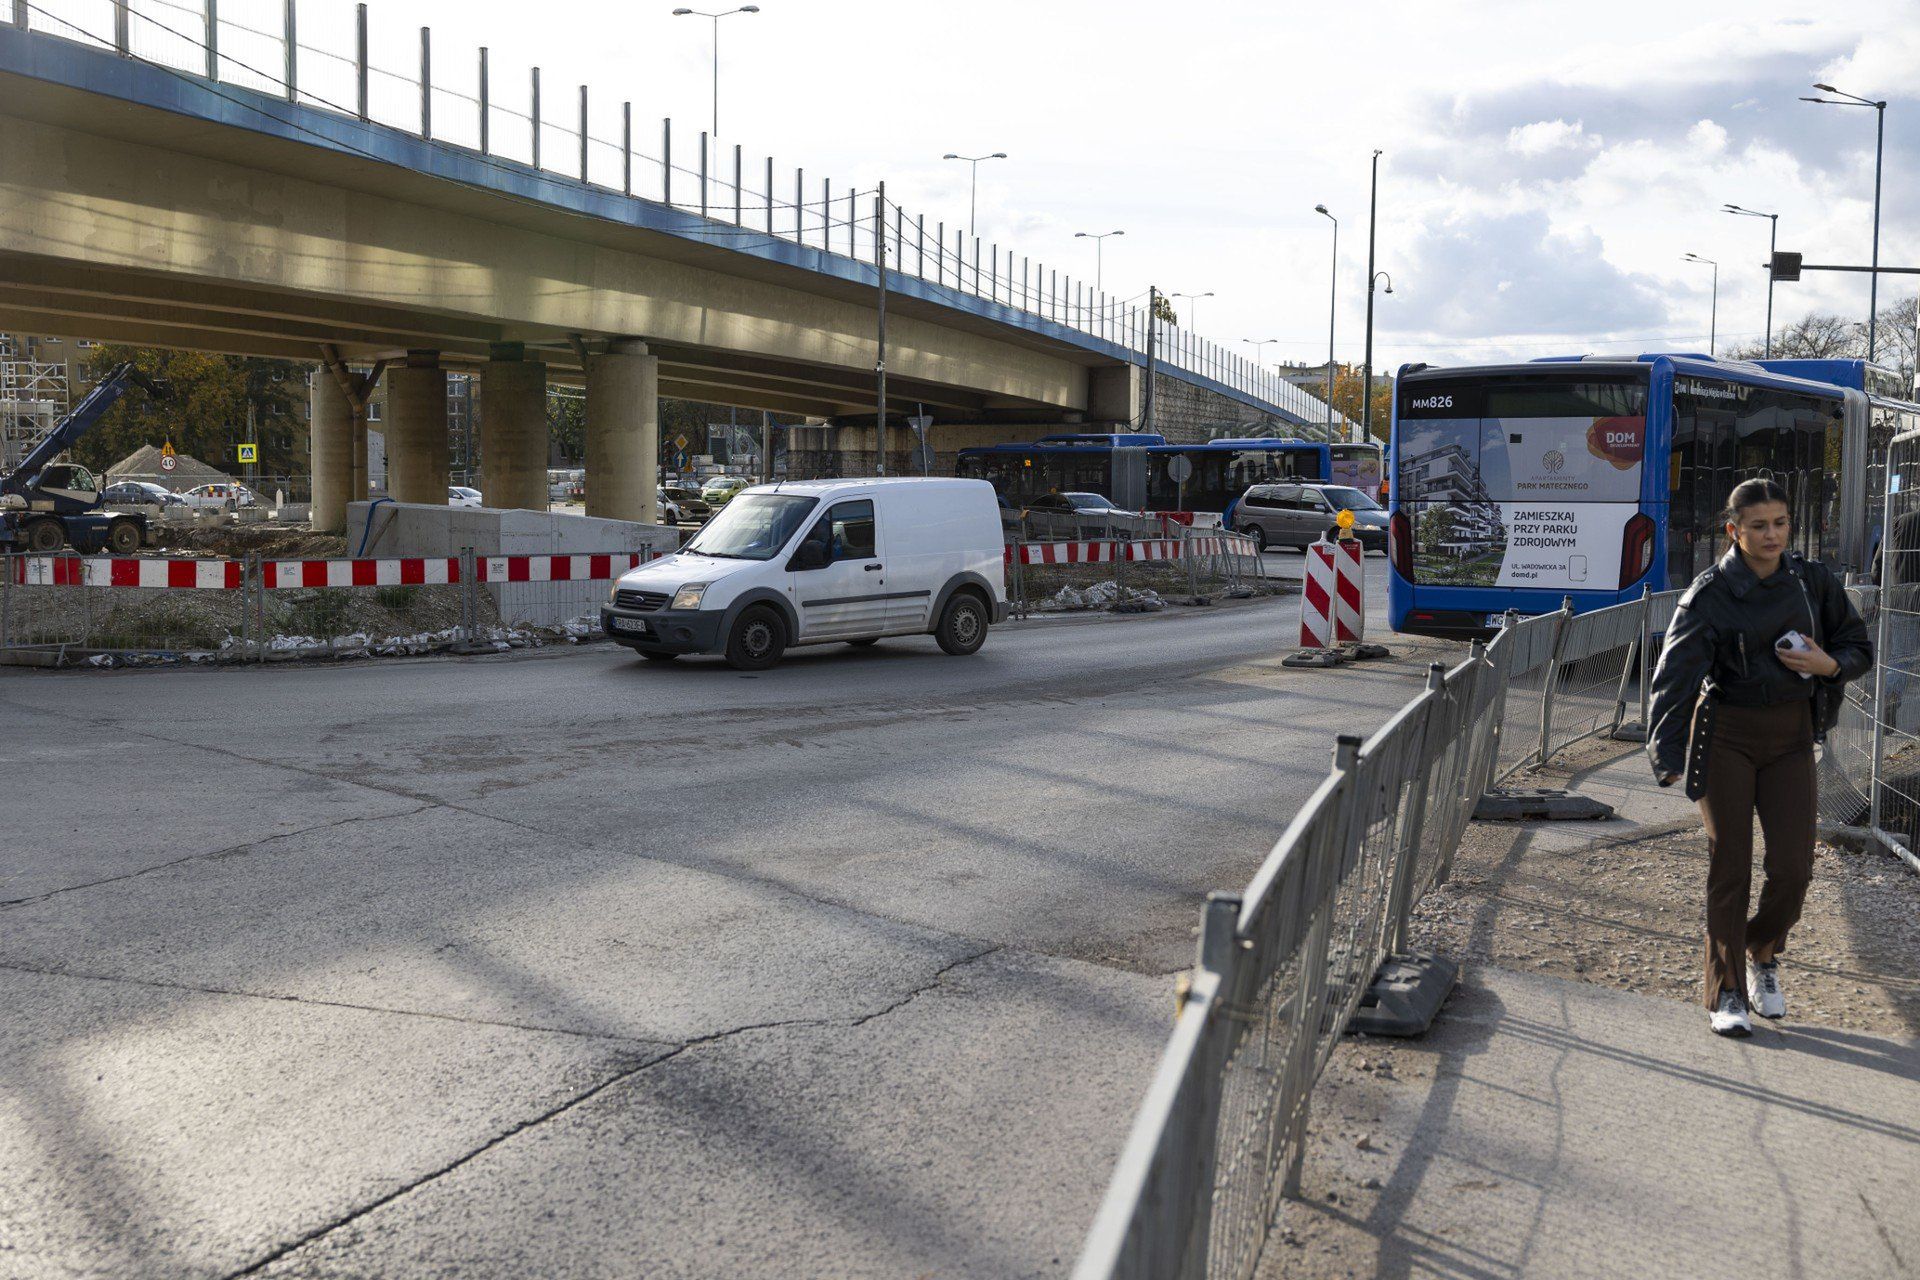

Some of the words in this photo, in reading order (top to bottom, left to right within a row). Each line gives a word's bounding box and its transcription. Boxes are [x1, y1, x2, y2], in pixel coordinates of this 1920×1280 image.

[1412, 396, 1453, 409] MM826
[1606, 432, 1635, 443] DOM
[163, 459, 174, 467] 40
[1517, 482, 1537, 490] PARK
[1539, 482, 1589, 490] MATECZNEGO
[1514, 511, 1575, 522] ZAMIESZKAJ
[1514, 524, 1541, 534] PRZY
[1543, 525, 1578, 534] PARKU
[1513, 537, 1576, 548] ZDROJOWYM
[1521, 563, 1557, 571] WADOWICKA
[1511, 571, 1538, 579] domd.pl
